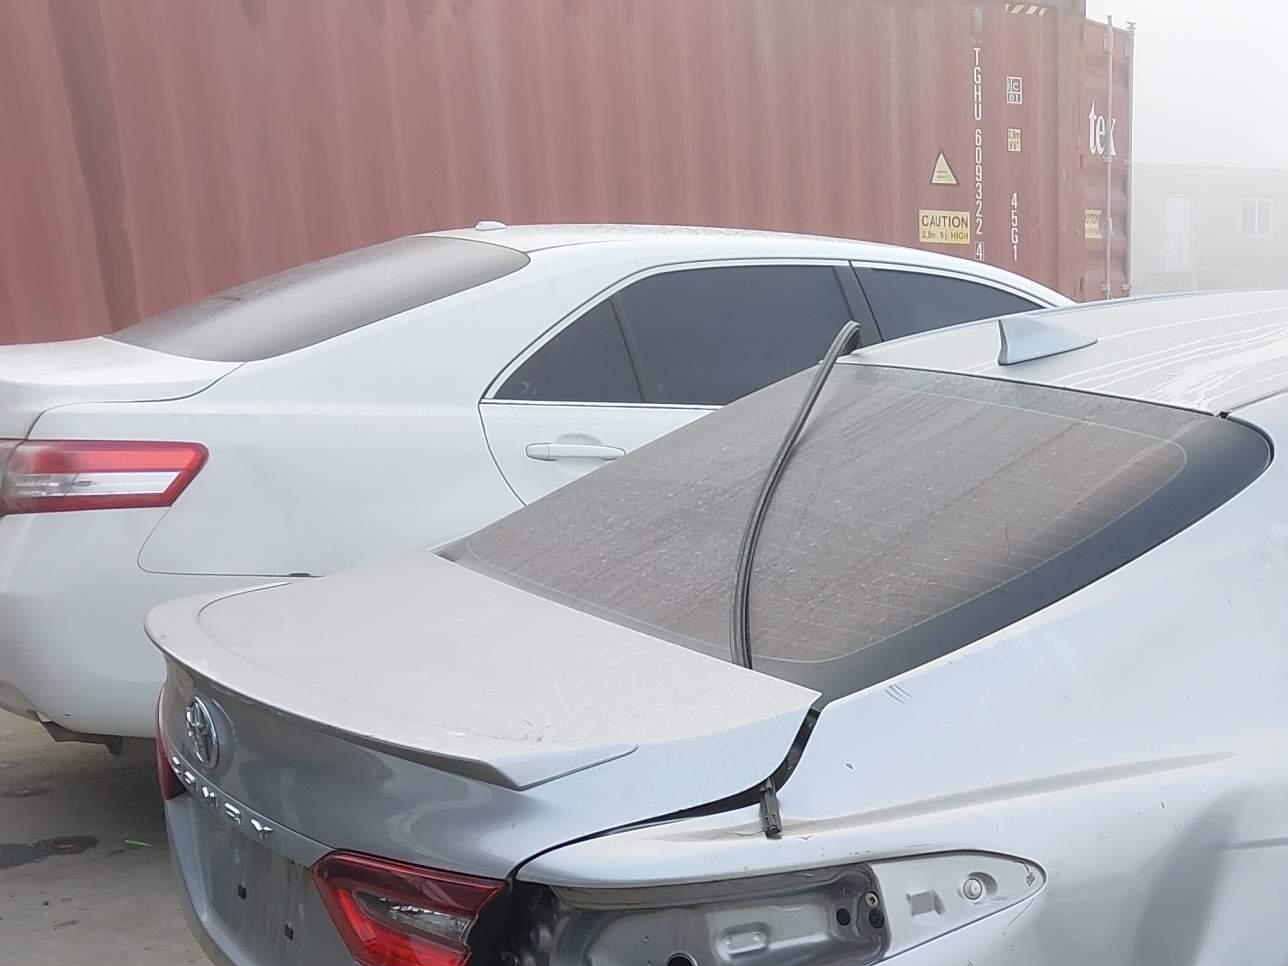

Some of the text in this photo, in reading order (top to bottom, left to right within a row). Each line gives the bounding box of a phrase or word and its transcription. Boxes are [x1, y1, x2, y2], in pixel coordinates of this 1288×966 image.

[973, 47, 984, 260] TGHU 609322 4
[921, 214, 969, 229] CAUTION
[950, 231, 969, 241] HIGH
[1010, 191, 1019, 262] 45G1
